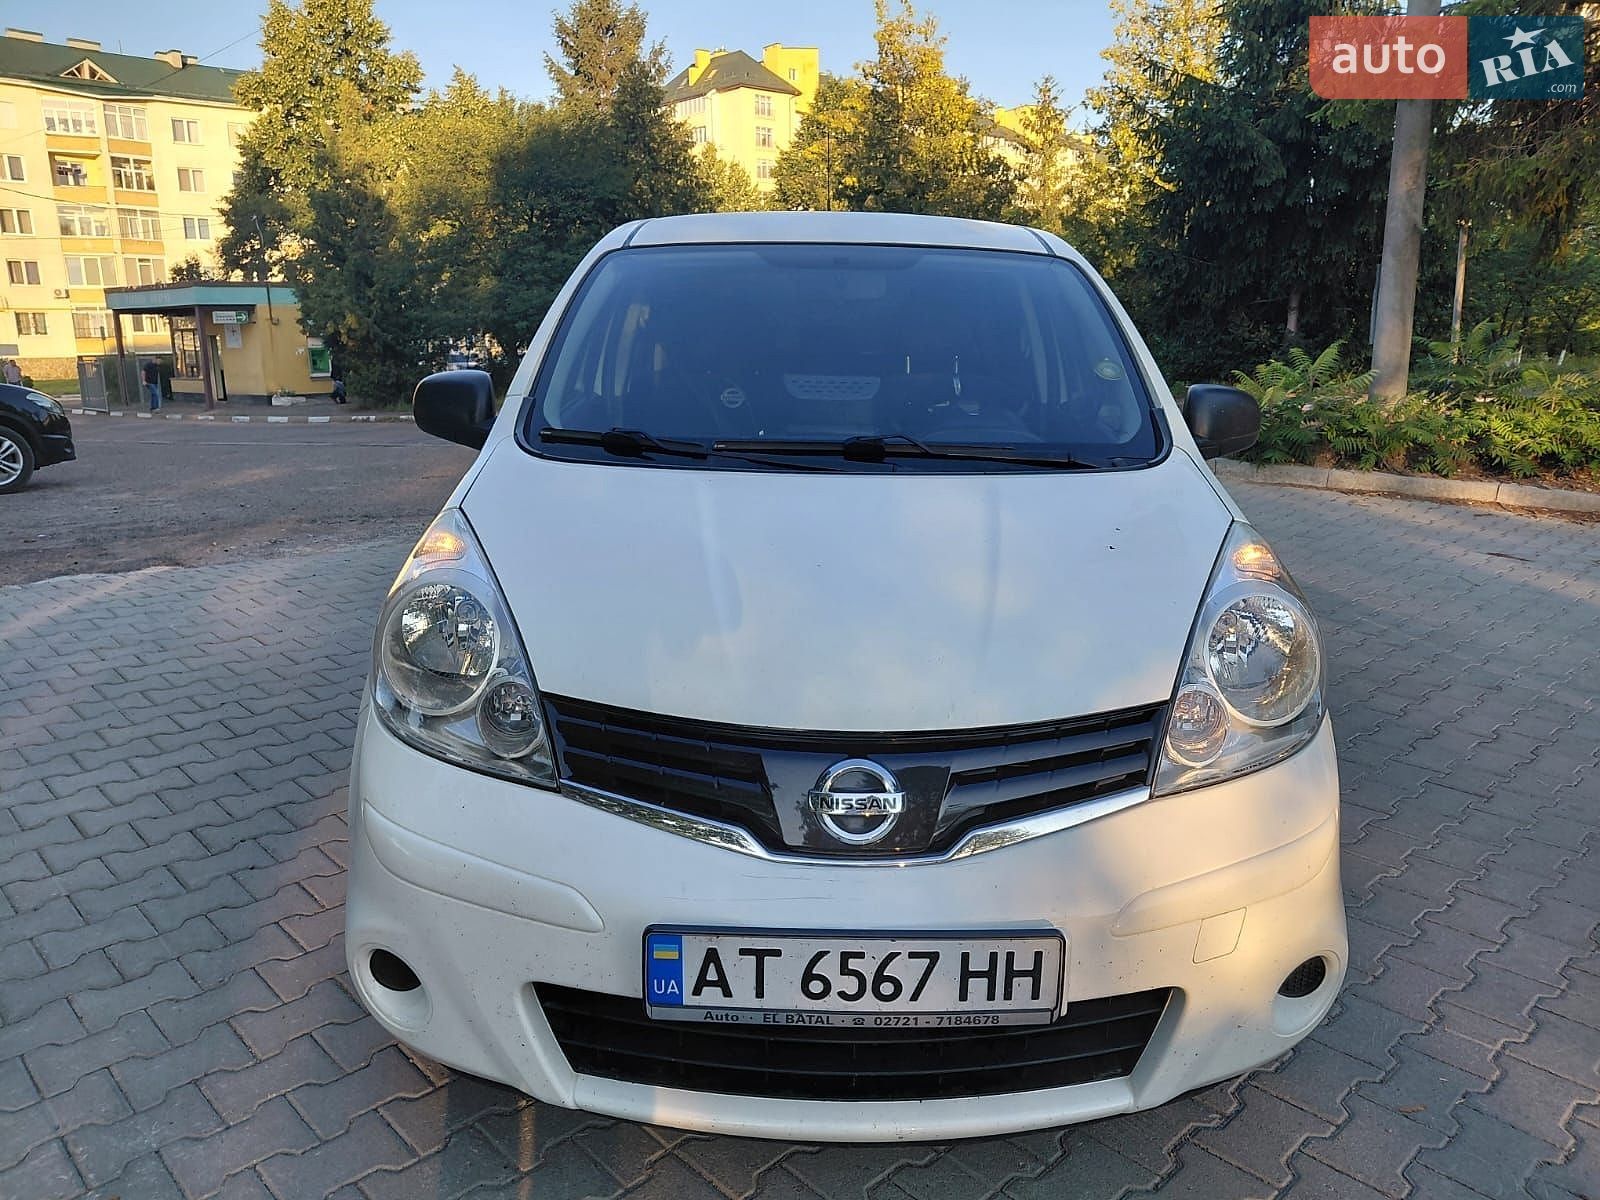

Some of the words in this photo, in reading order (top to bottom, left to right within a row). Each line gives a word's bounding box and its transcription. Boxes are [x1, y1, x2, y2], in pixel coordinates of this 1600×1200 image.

[820, 796, 897, 810] NISSAN
[692, 947, 783, 999] AT
[800, 950, 941, 1002] 6567
[959, 951, 1044, 1002] HH
[653, 980, 680, 995] UA
[704, 1011, 739, 1023] Auto
[763, 1013, 780, 1024] EL
[785, 1013, 833, 1025] BATAL
[874, 1016, 919, 1026] 02721
[936, 1015, 1000, 1026] 7184678
